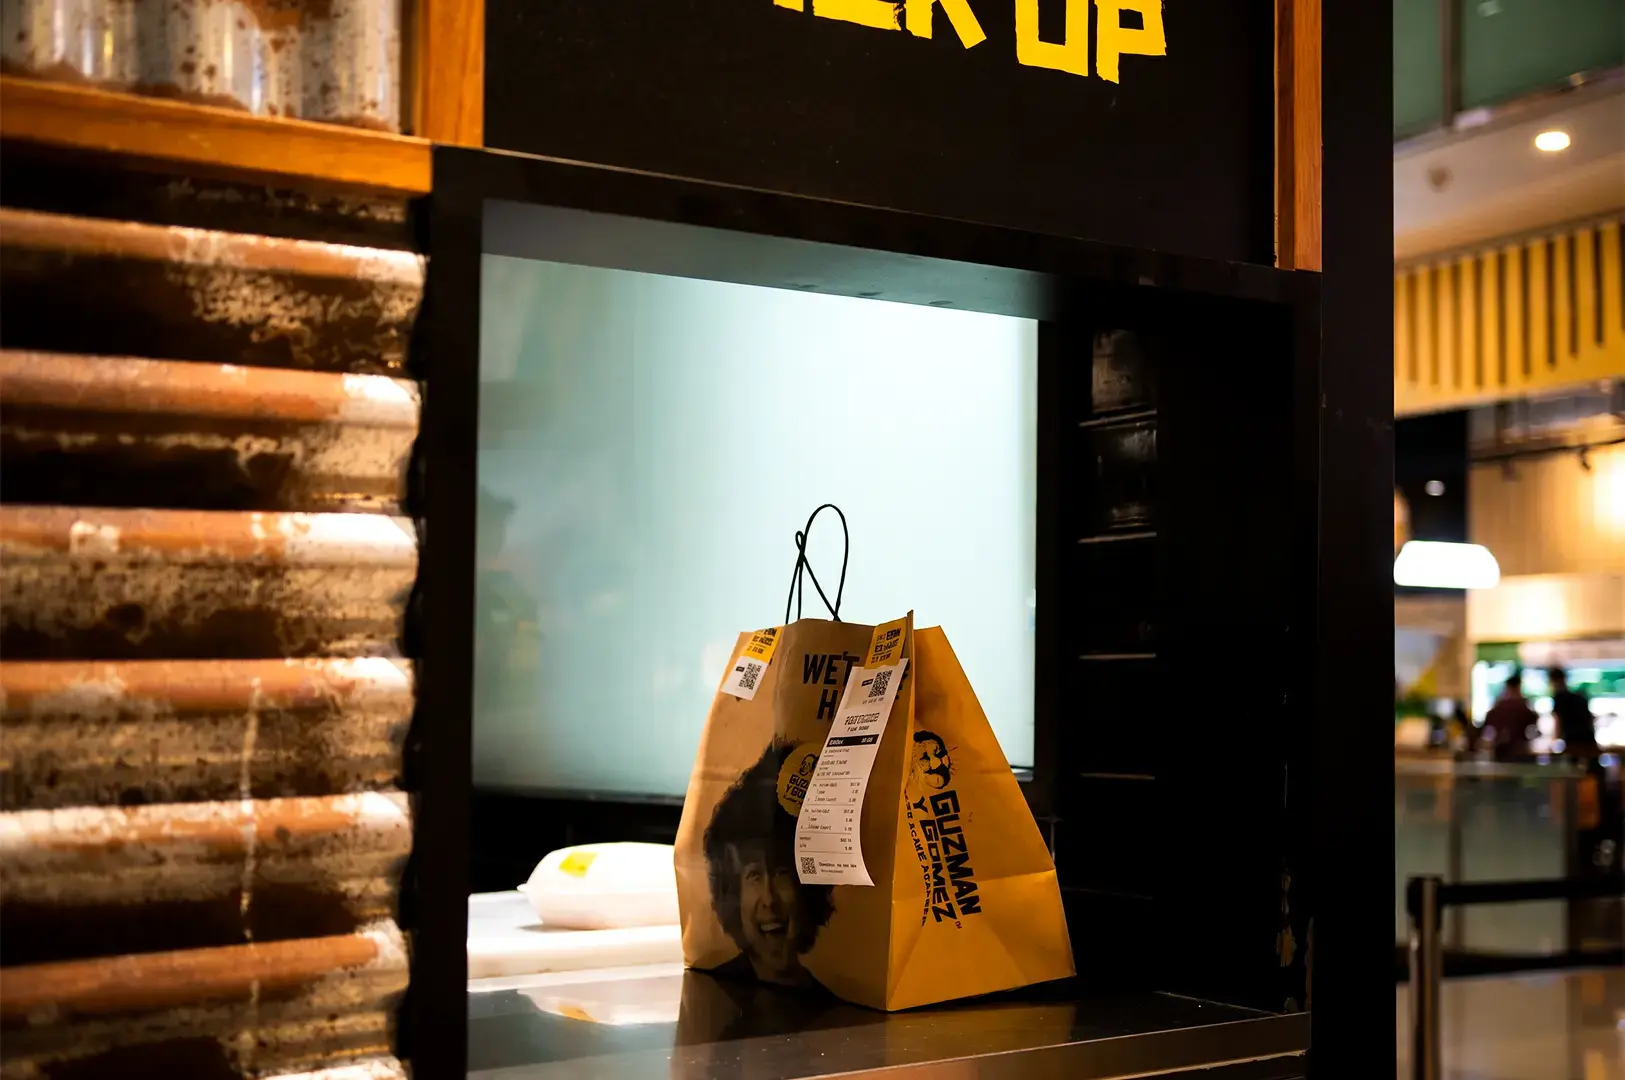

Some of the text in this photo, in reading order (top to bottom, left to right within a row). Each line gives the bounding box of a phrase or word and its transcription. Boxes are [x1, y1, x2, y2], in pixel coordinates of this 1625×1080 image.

[912, 796, 929, 814] Y
[929, 789, 982, 916] GUZMAN
[919, 819, 957, 923] GOMEZ
